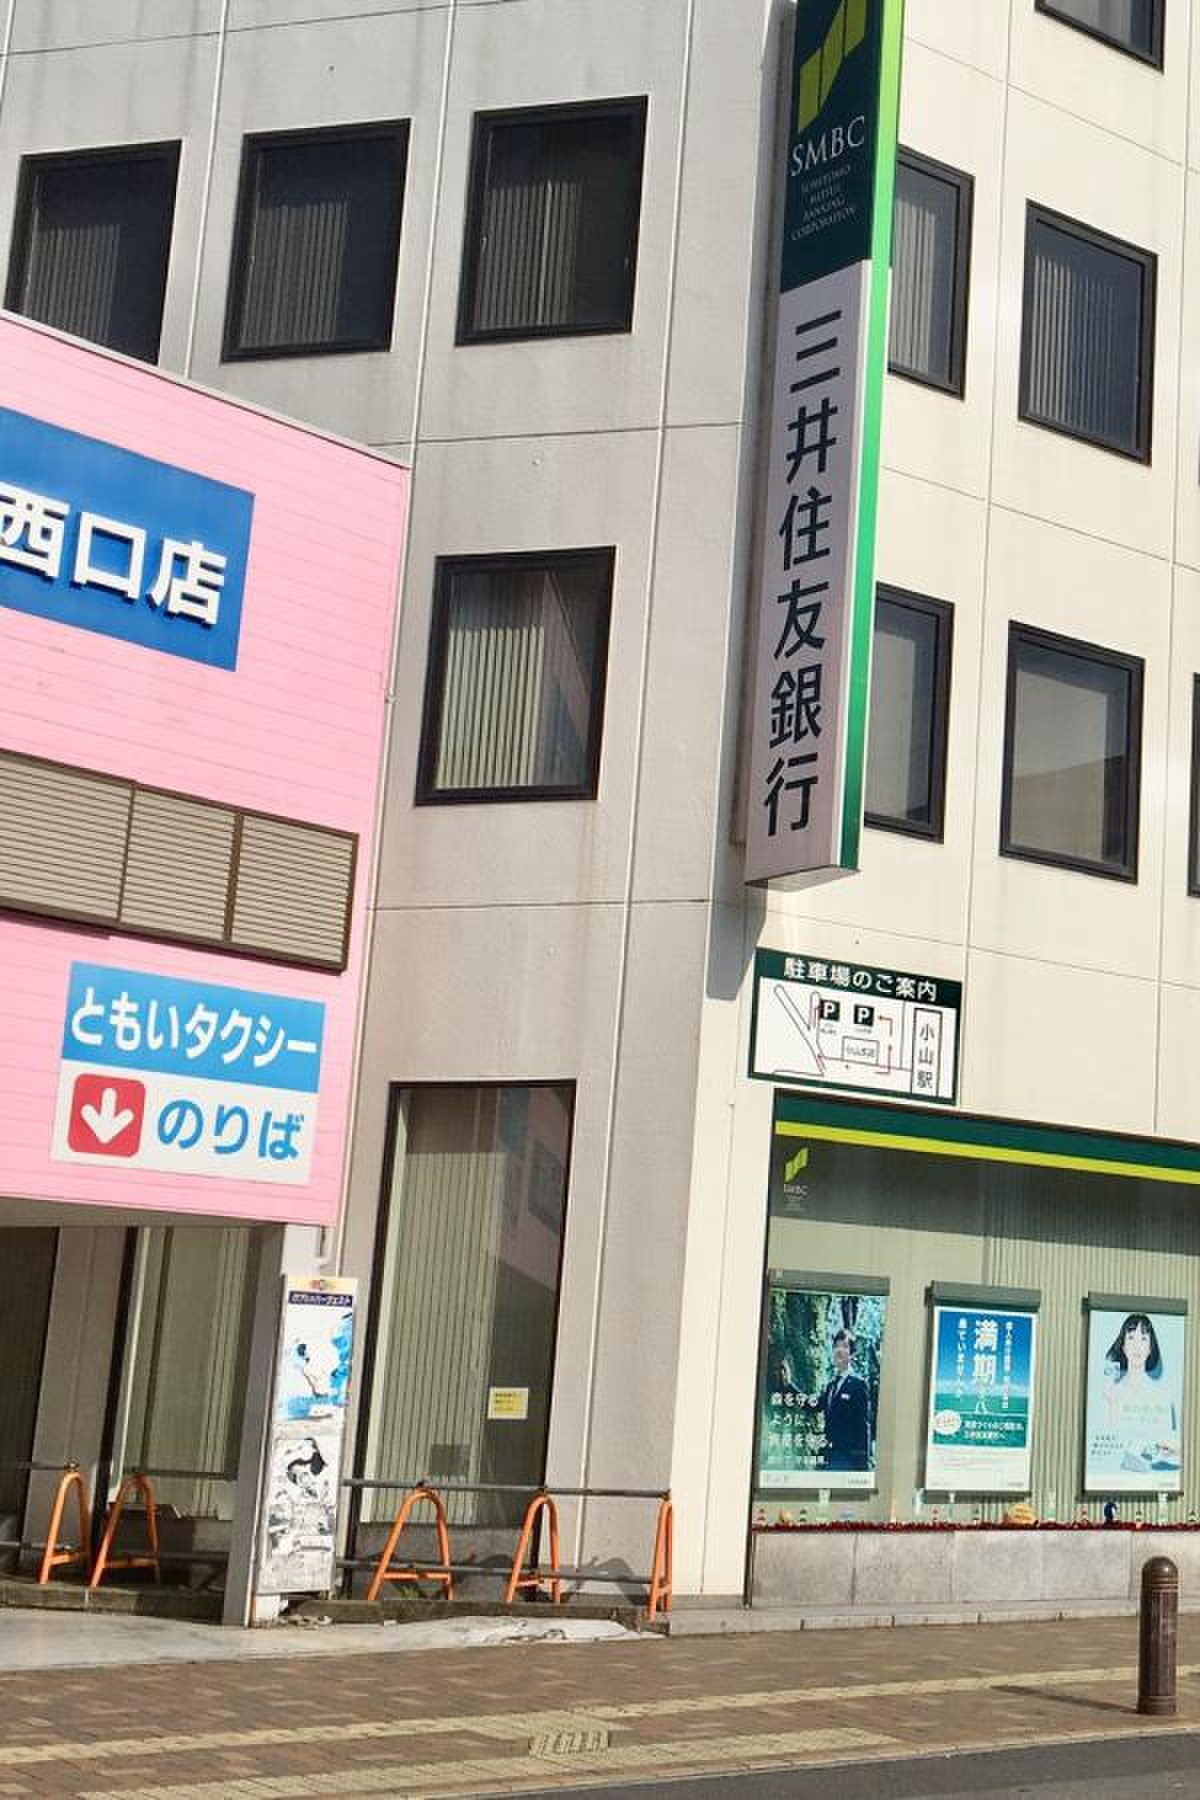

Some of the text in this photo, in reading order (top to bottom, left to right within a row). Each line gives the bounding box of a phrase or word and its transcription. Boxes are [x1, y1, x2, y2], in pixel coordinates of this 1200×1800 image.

[790, 115, 865, 177] SMBC
[0, 482, 227, 625] 西口店
[764, 309, 842, 837] 三井住友銀行
[784, 957, 937, 1002] 駐車場のご案内
[71, 986, 317, 1068] ともいタクシー
[917, 1023, 935, 1089] 小山駅
[157, 1099, 304, 1160] のりば
